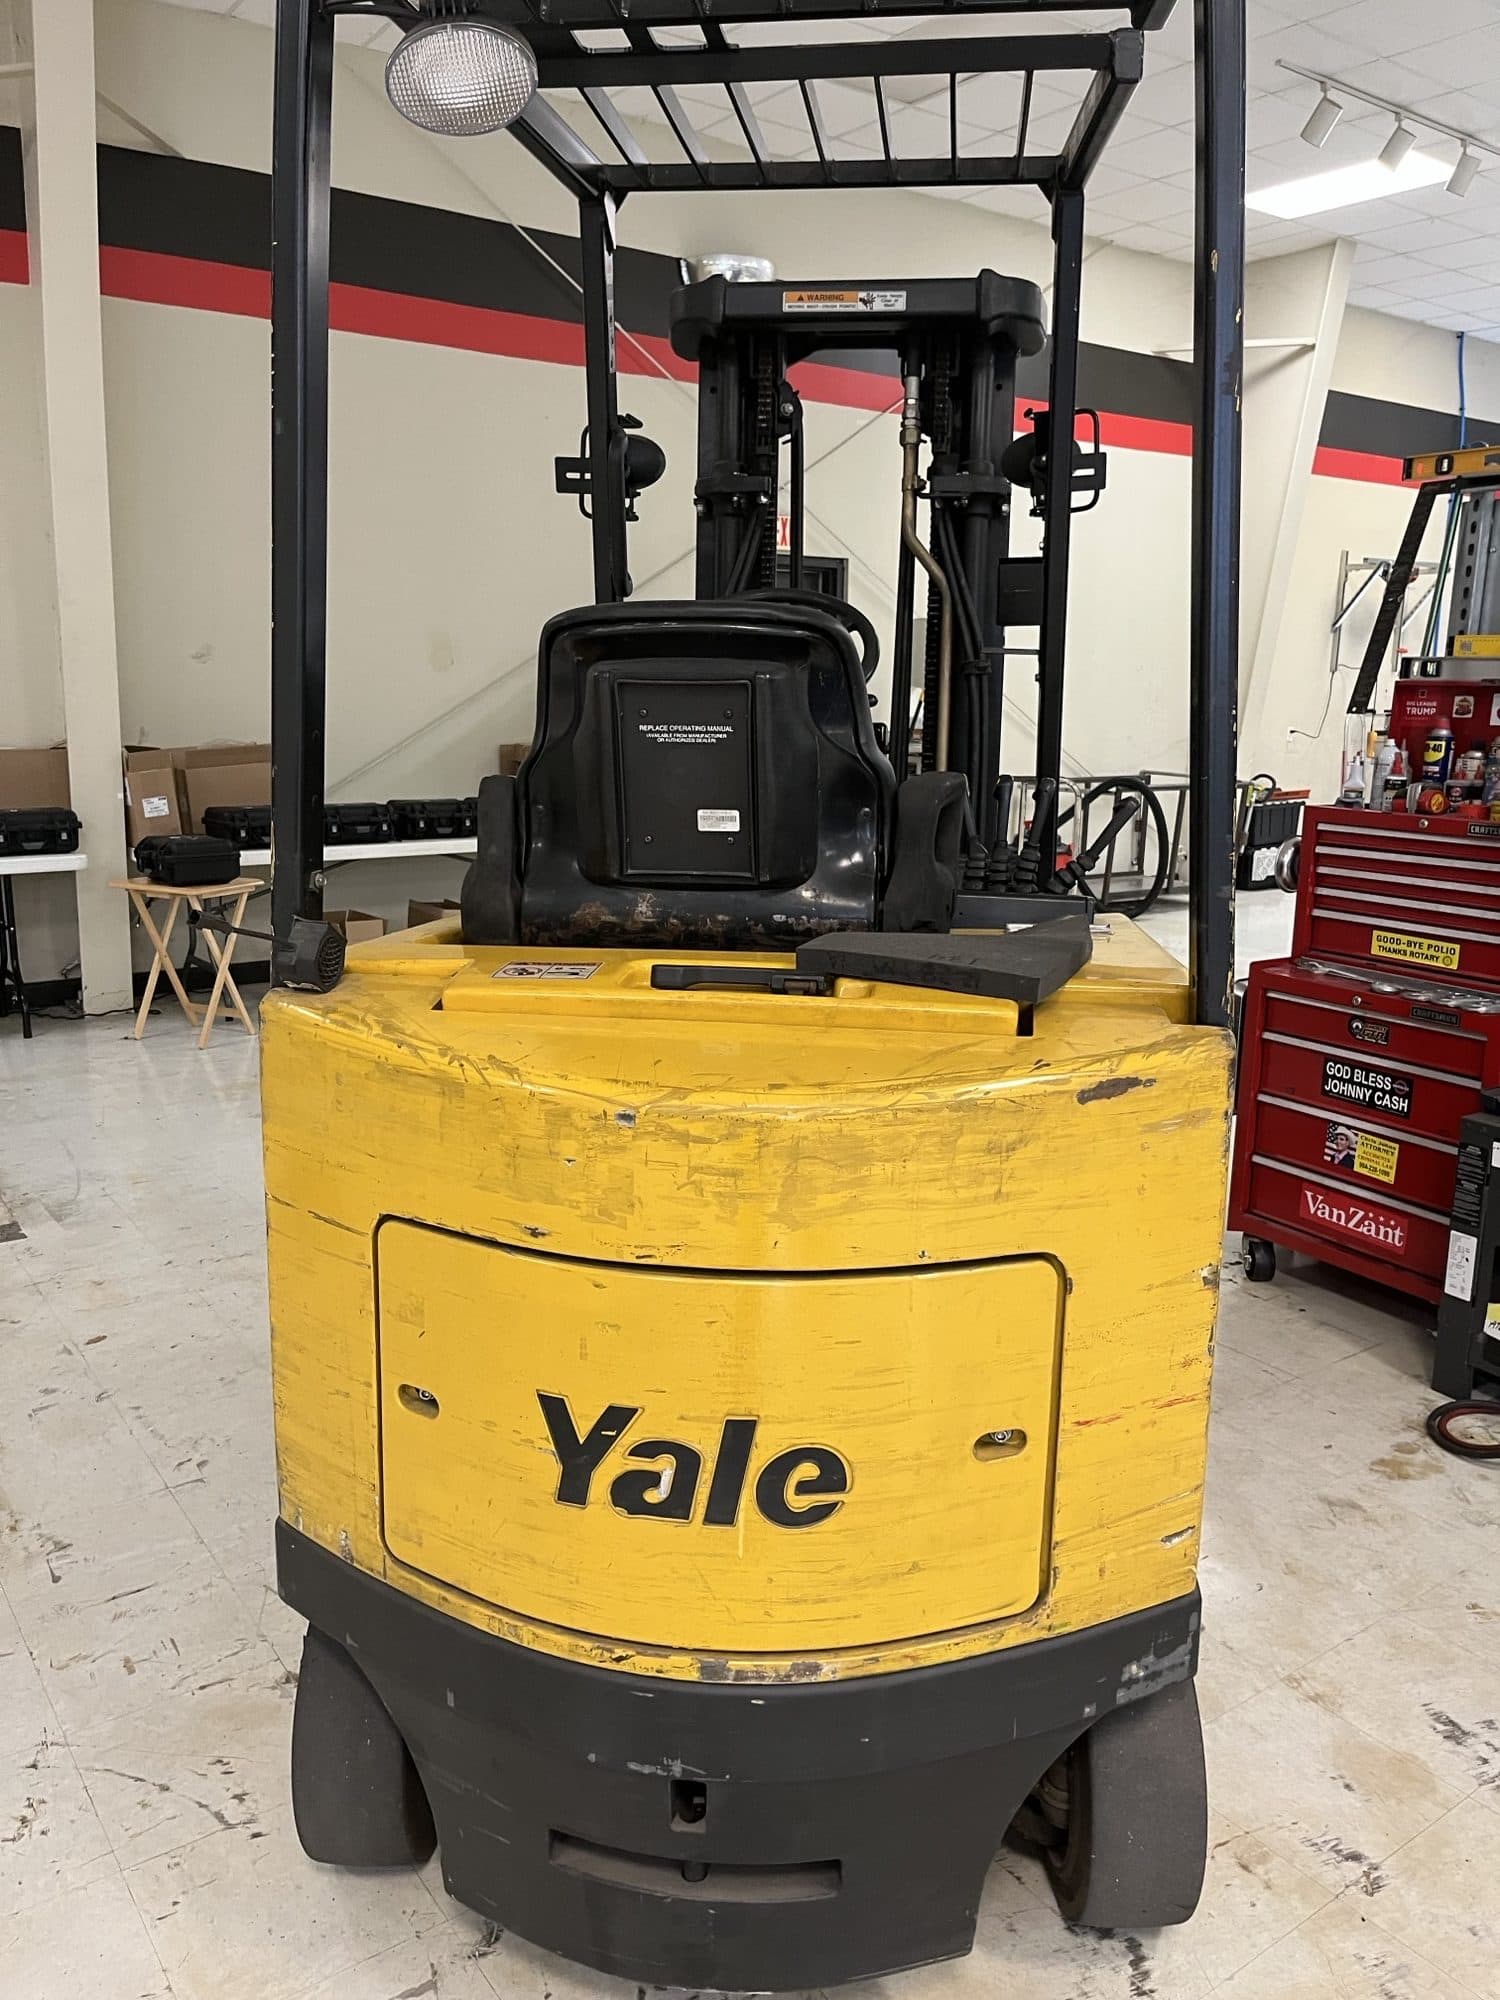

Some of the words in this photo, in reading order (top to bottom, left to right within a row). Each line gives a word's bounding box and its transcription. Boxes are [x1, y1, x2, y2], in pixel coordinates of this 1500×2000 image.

[807, 294, 845, 302] WARNING
[1406, 706, 1437, 716] TRUMP
[639, 724, 669, 732] REPLACE
[1376, 934, 1425, 950] GOOD-BYE
[1427, 943, 1456, 956] POLIO
[1378, 945, 1408, 957] THANKS
[1409, 950, 1440, 963] ROTARY
[1326, 1061, 1351, 1079] GOD
[1353, 1068, 1392, 1091] BLESS
[1324, 1077, 1373, 1102] JOHNNY
[1374, 1091, 1409, 1113] CASH
[1361, 1141, 1395, 1157] ATTORNEY
[535, 1389, 853, 1530] Yale
